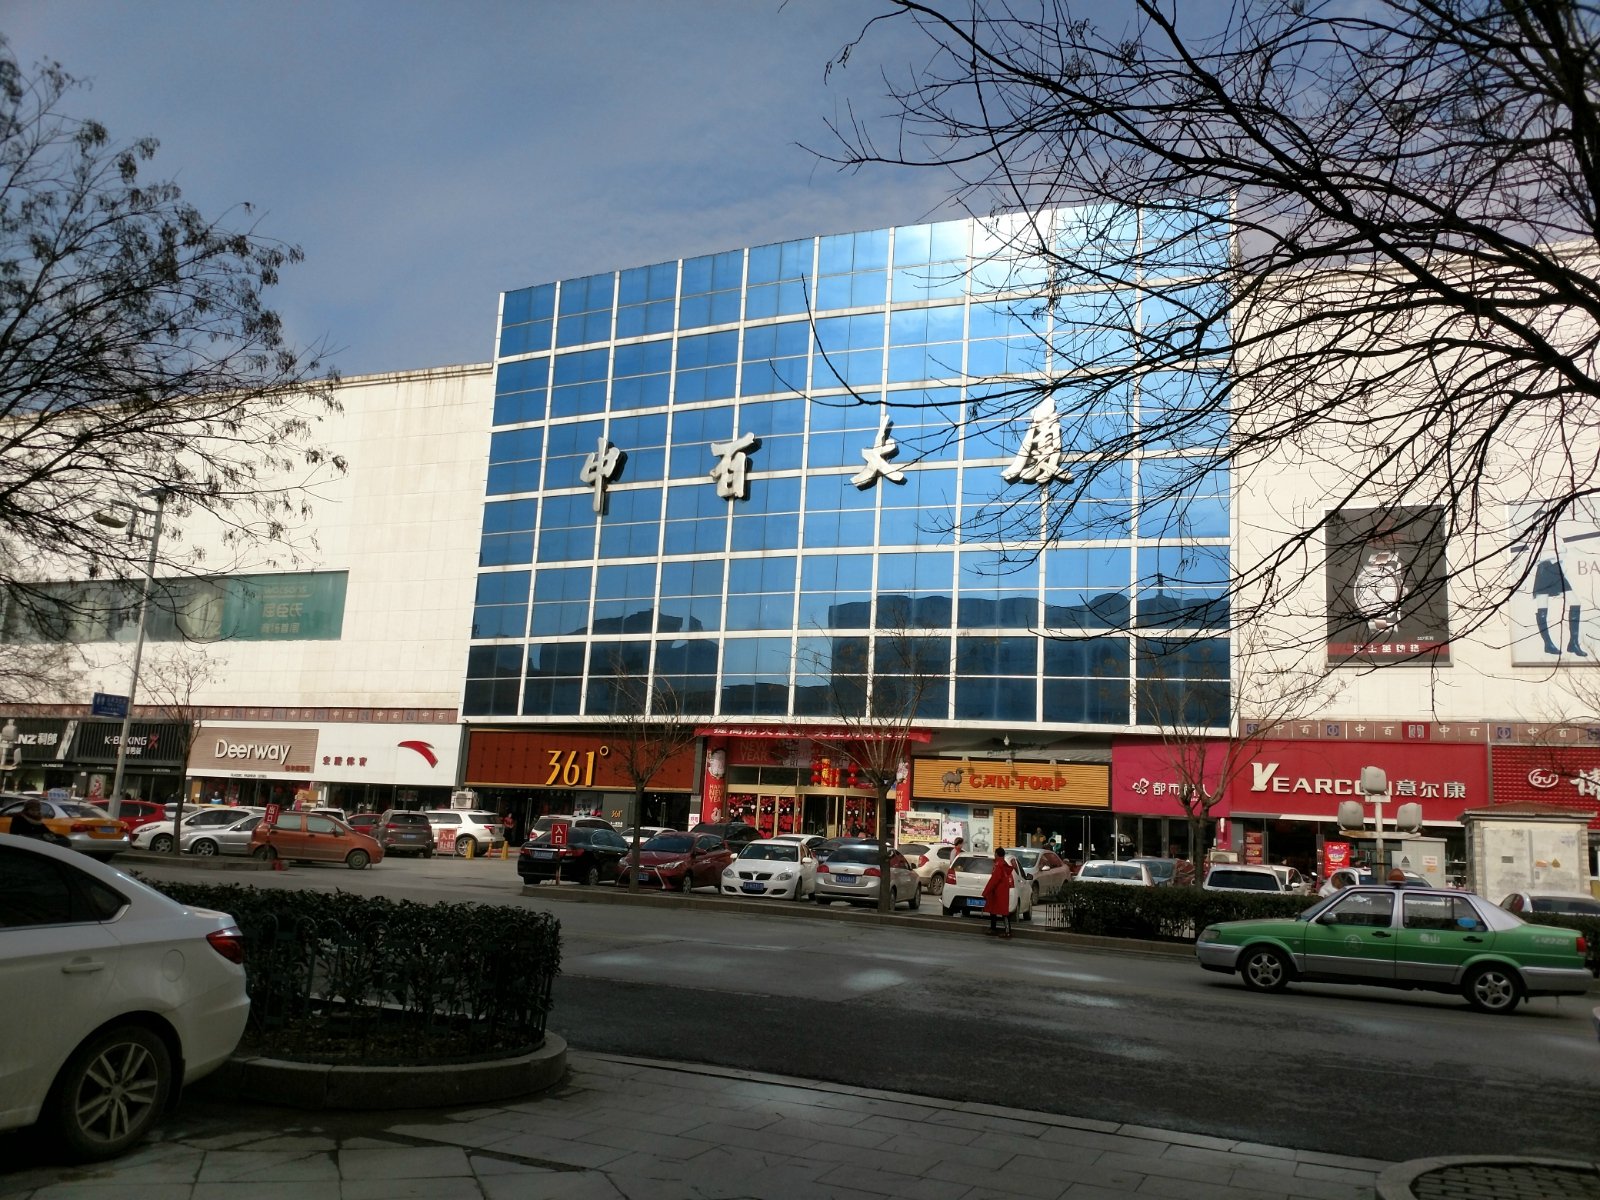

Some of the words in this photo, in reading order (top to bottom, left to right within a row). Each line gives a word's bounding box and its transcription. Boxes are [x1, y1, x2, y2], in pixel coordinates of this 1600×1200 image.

[579, 397, 1076, 513] 中百大厦
[262, 602, 304, 618] 屈臣氏
[332, 709, 354, 720] 中百
[376, 709, 400, 721] 中百
[422, 709, 446, 721] 中百
[37, 732, 58, 746] 利郎
[1273, 723, 1313, 736] 中百
[1354, 723, 1395, 737] 中百
[1438, 724, 1481, 739] 中百
[1527, 725, 1571, 740] 中百
[104, 735, 147, 746] K-BXING
[740, 741, 768, 752] NEW
[214, 739, 291, 765] Deerway
[740, 751, 768, 763] YEAR
[545, 745, 609, 787] 361°
[1250, 762, 1393, 797] YEARCO
[1395, 779, 1467, 799] 意尔康
[266, 805, 277, 822] 出口
[440, 832, 455, 841] 入口
[555, 825, 563, 844] 入口
